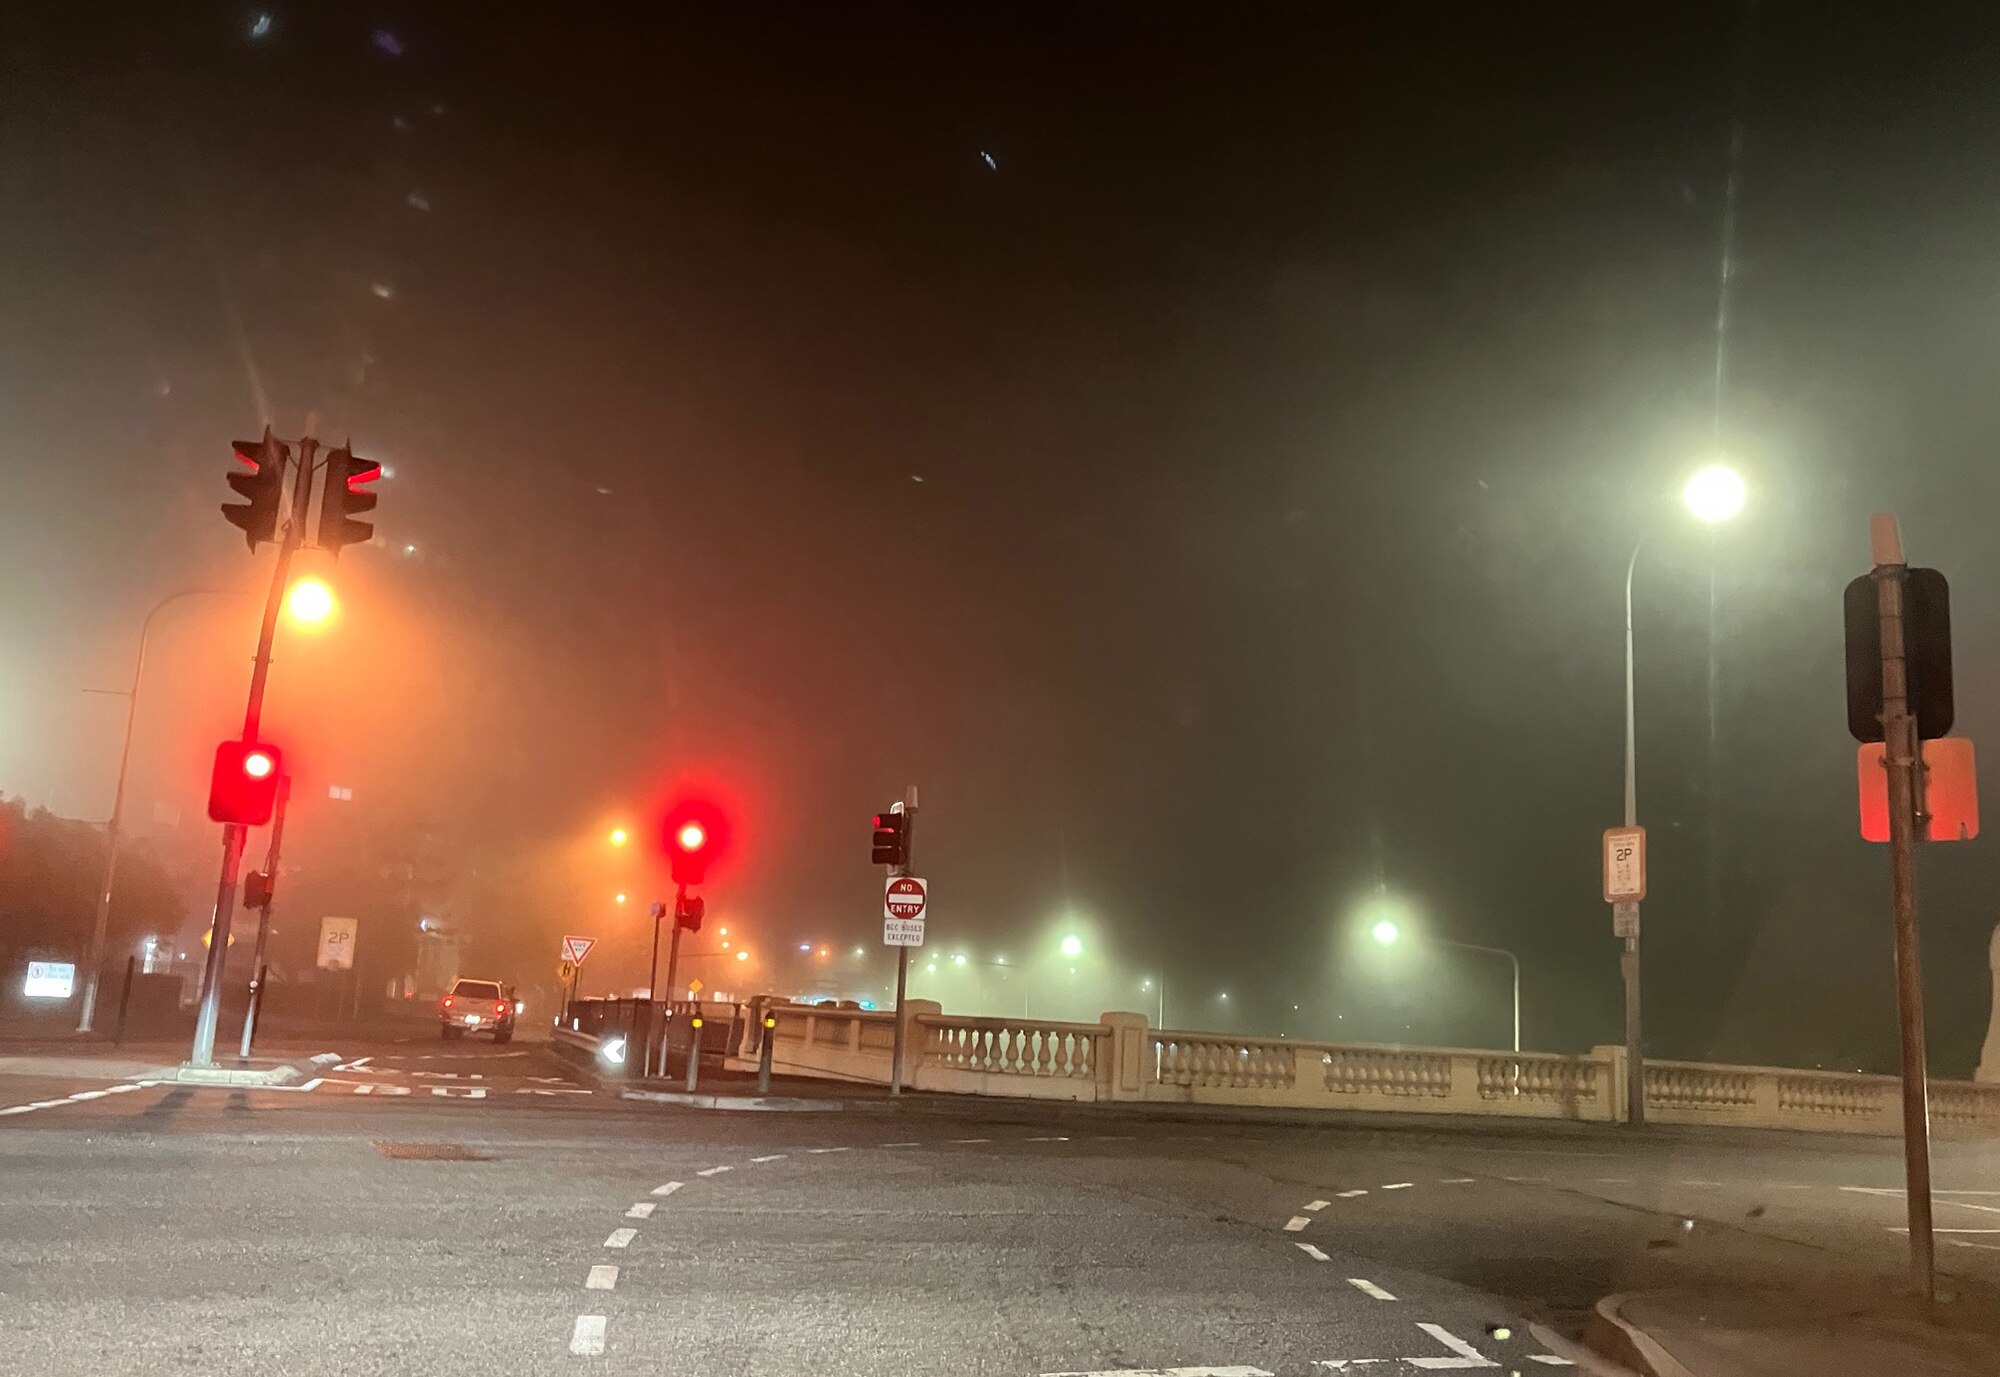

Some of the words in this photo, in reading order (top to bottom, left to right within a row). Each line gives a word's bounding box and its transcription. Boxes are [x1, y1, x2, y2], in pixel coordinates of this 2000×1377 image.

[1616, 848, 1632, 862] 2P
[900, 883, 913, 892] NO
[890, 904, 920, 914] ENTRY
[328, 931, 350, 944] 2P
[888, 933, 920, 942] EXCEPTED
